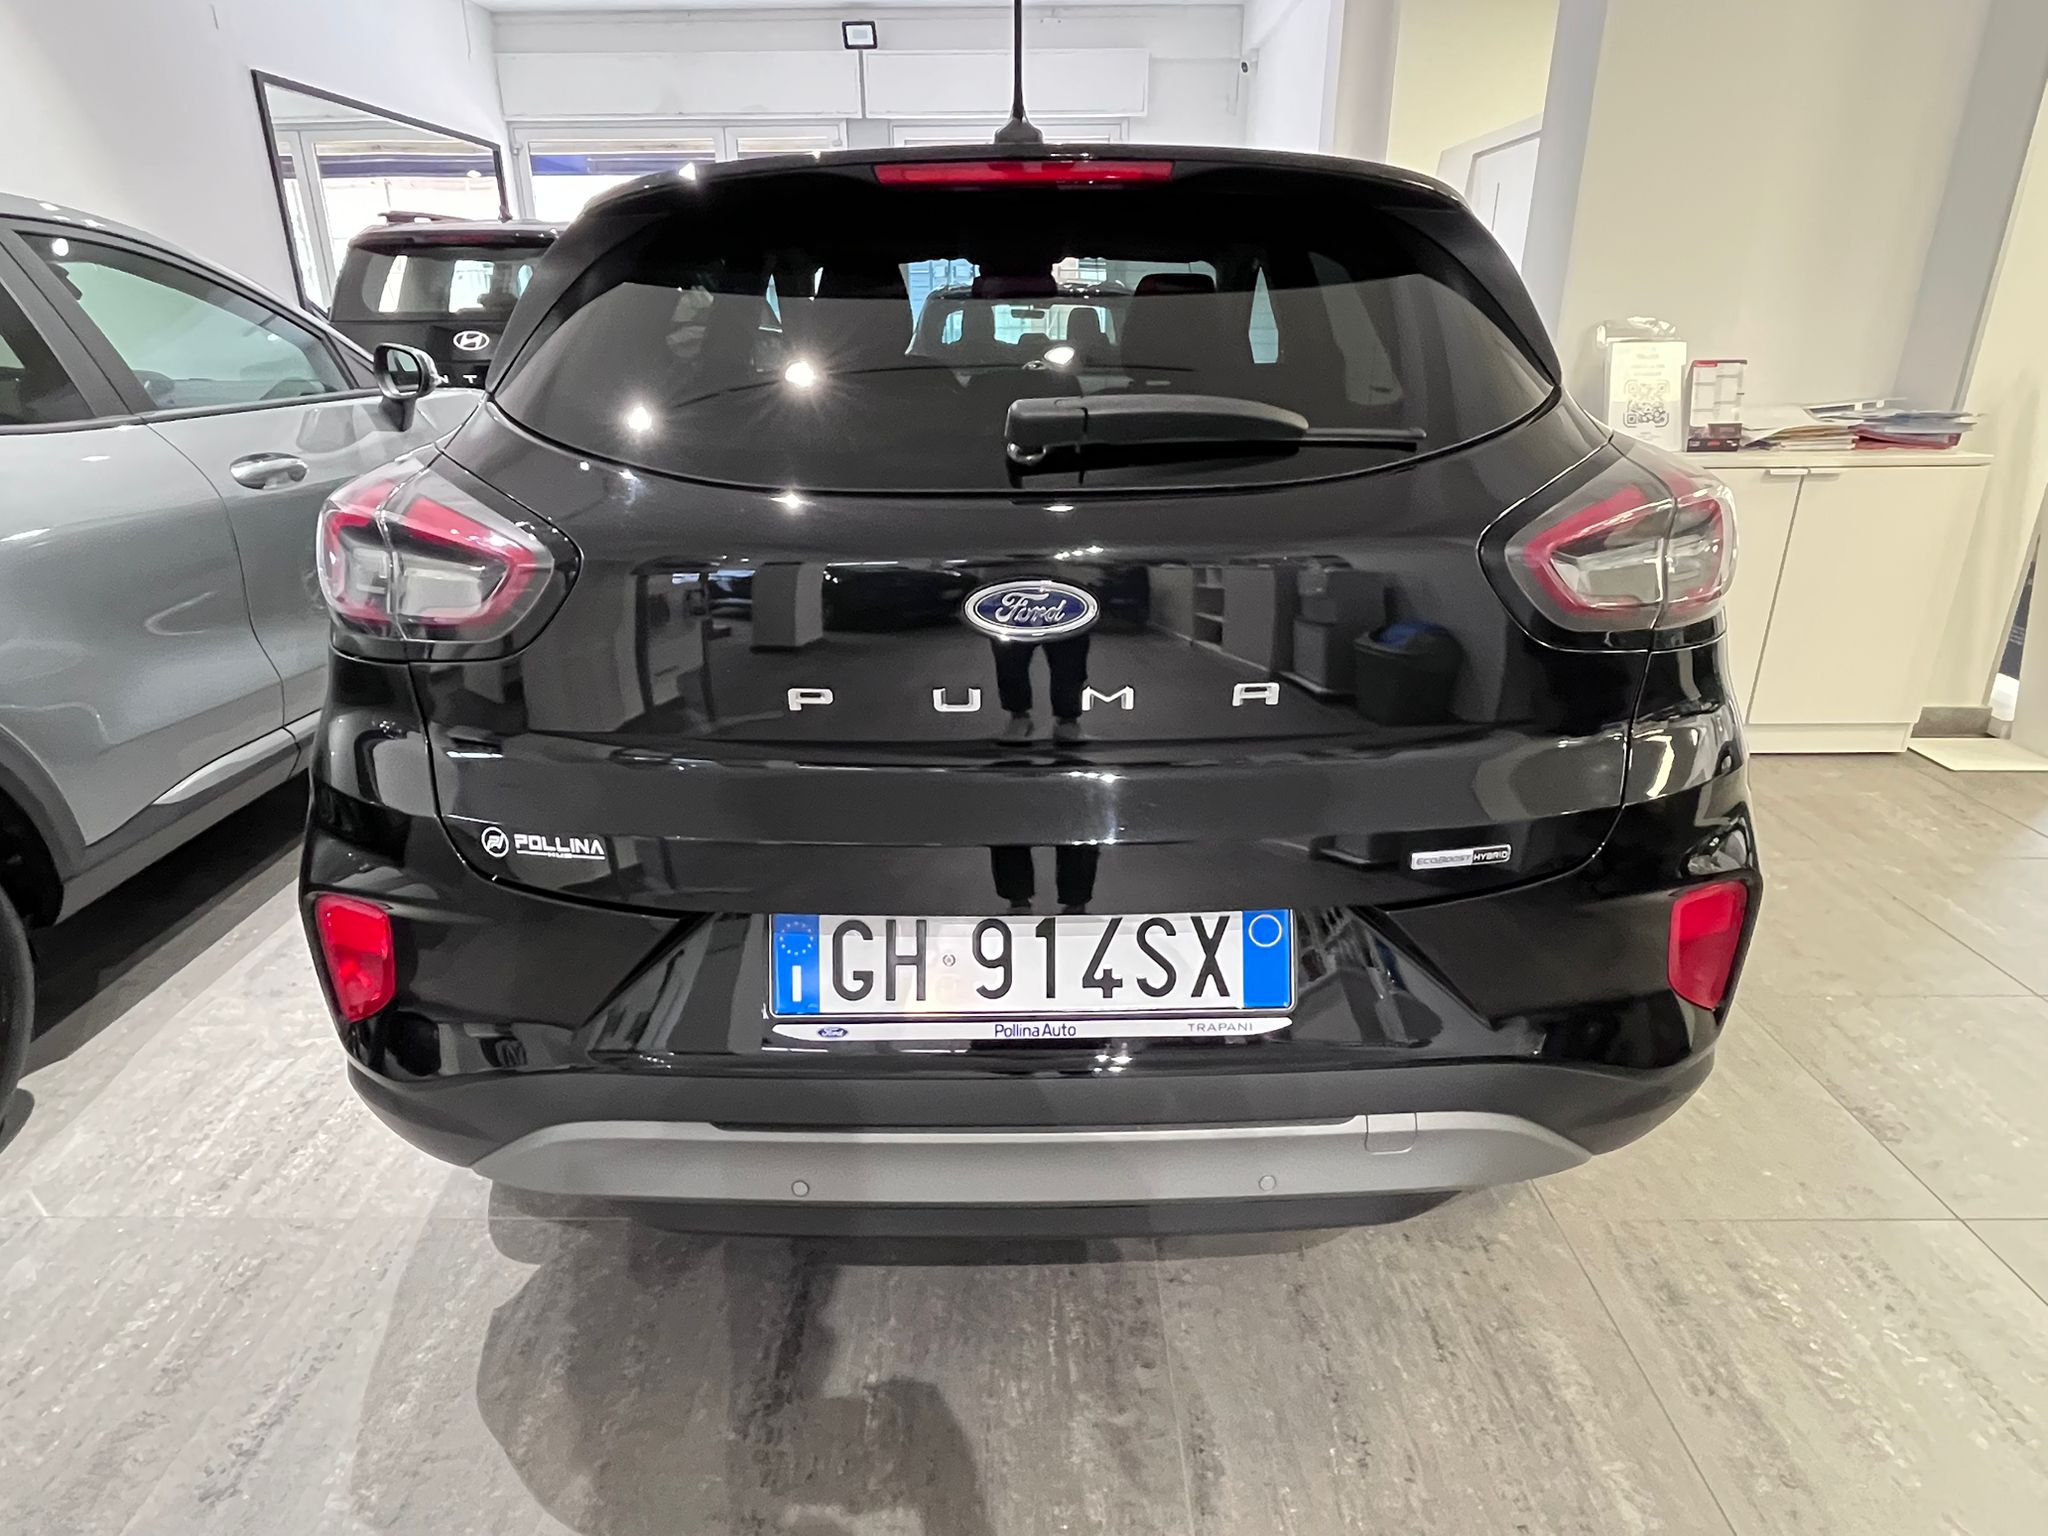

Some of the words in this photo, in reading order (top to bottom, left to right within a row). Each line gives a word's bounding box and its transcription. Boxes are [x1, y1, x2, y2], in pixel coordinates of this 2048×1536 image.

[995, 592, 1067, 622] Ford
[788, 683, 1280, 712] PUMA
[514, 833, 605, 855] POLLINA
[1474, 850, 1508, 861] HYBRID
[832, 919, 927, 1001] GH
[972, 916, 1231, 999] 914SX
[791, 965, 802, 1002] I
[994, 1023, 1040, 1037] Pollina
[1041, 1023, 1077, 1037] Auto
[1187, 1022, 1253, 1033] TRAPANI
